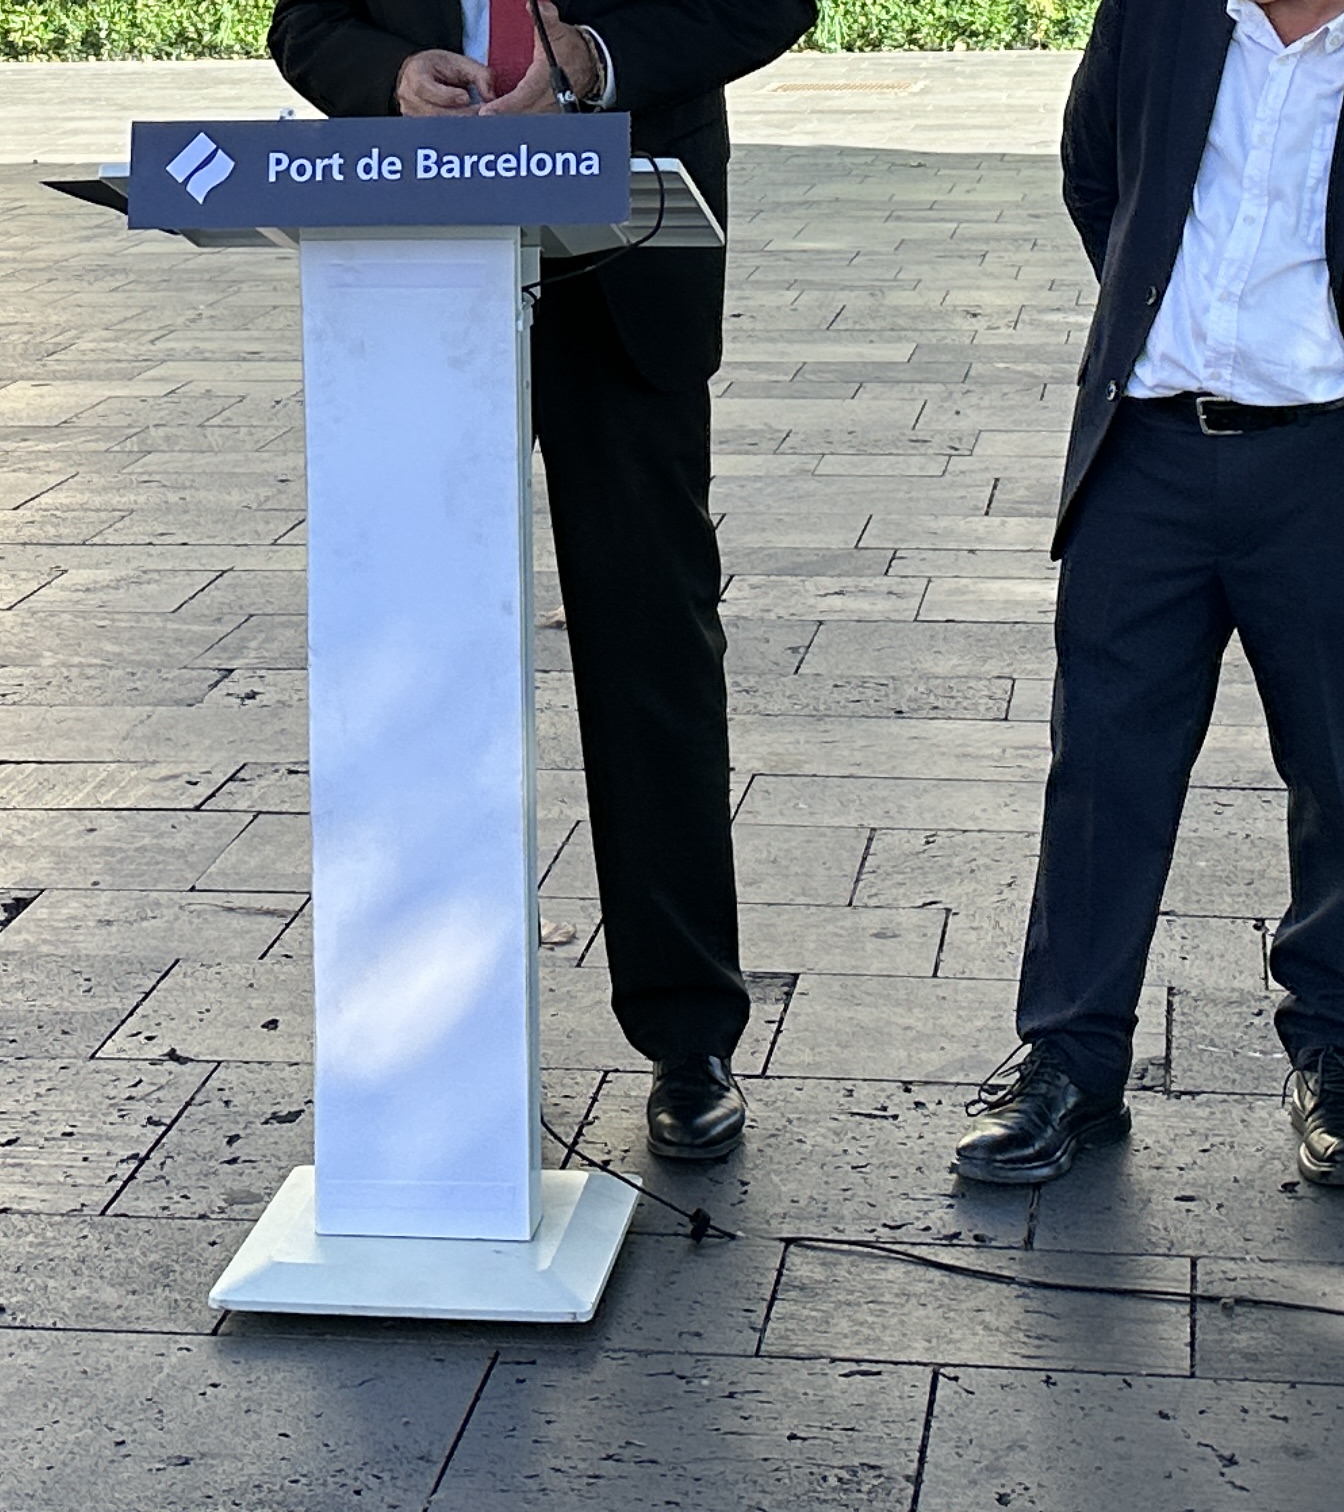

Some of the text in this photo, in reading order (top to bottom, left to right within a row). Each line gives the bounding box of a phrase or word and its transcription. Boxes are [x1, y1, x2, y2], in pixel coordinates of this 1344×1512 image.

[267, 144, 601, 183] Port de Barcelona
